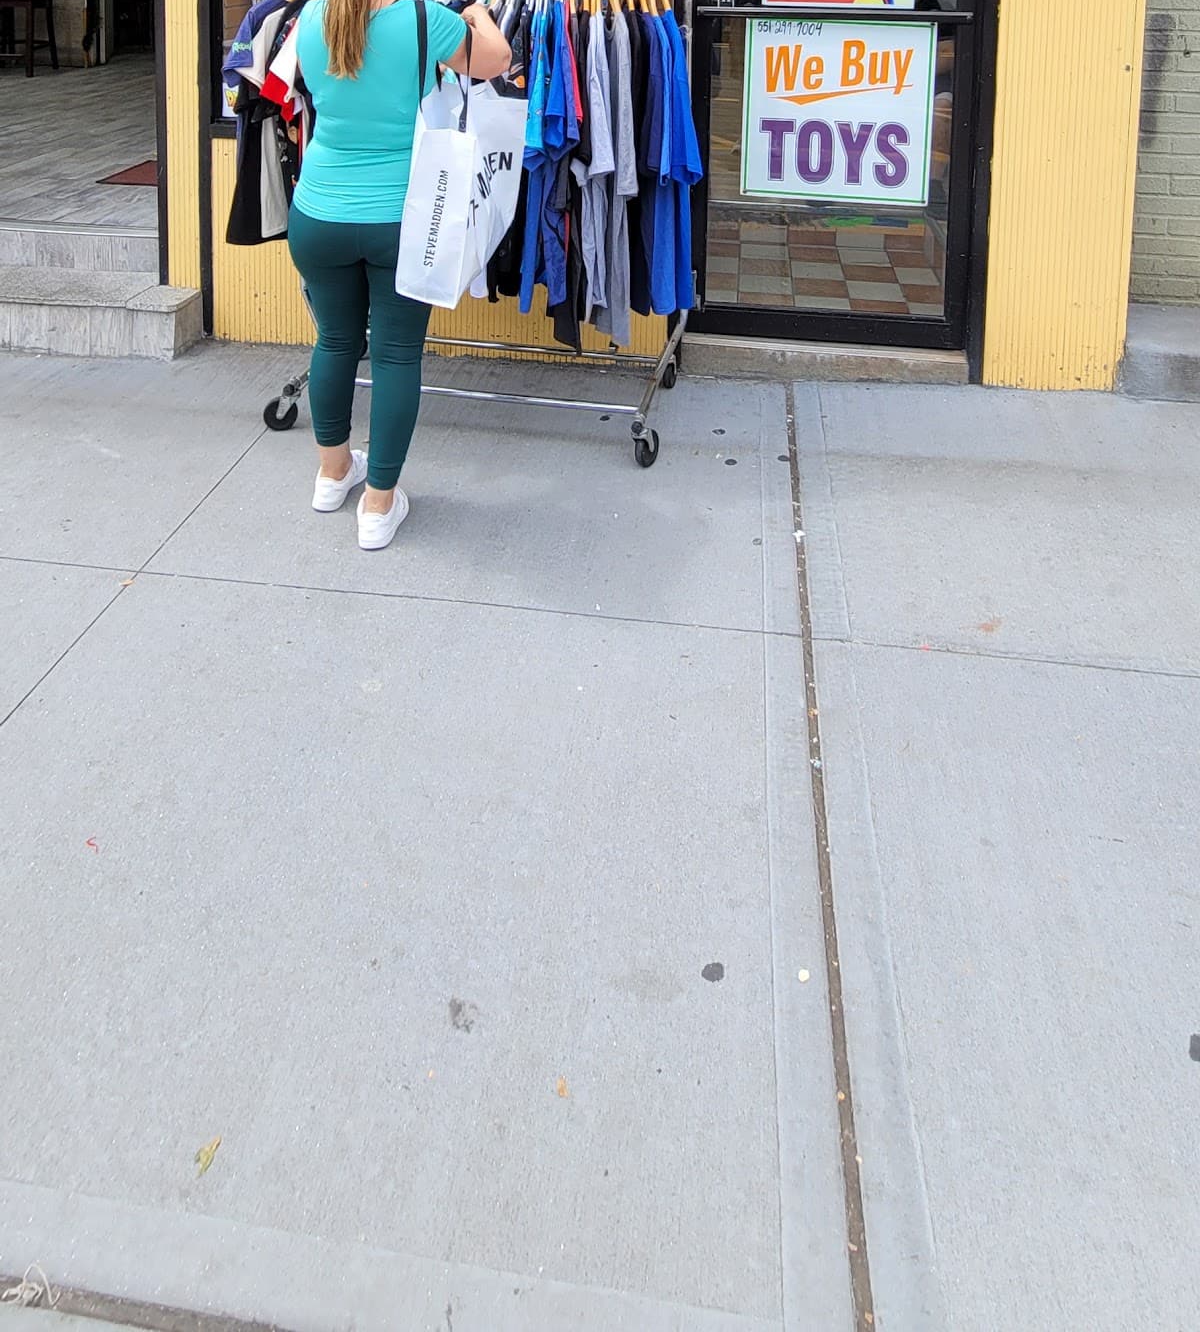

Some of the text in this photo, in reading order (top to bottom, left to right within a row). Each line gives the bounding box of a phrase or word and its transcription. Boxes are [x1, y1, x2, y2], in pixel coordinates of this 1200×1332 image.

[765, 39, 914, 95] We Buy
[759, 117, 911, 189] TOYS
[423, 169, 449, 268] STEVEMADDEN.COM
